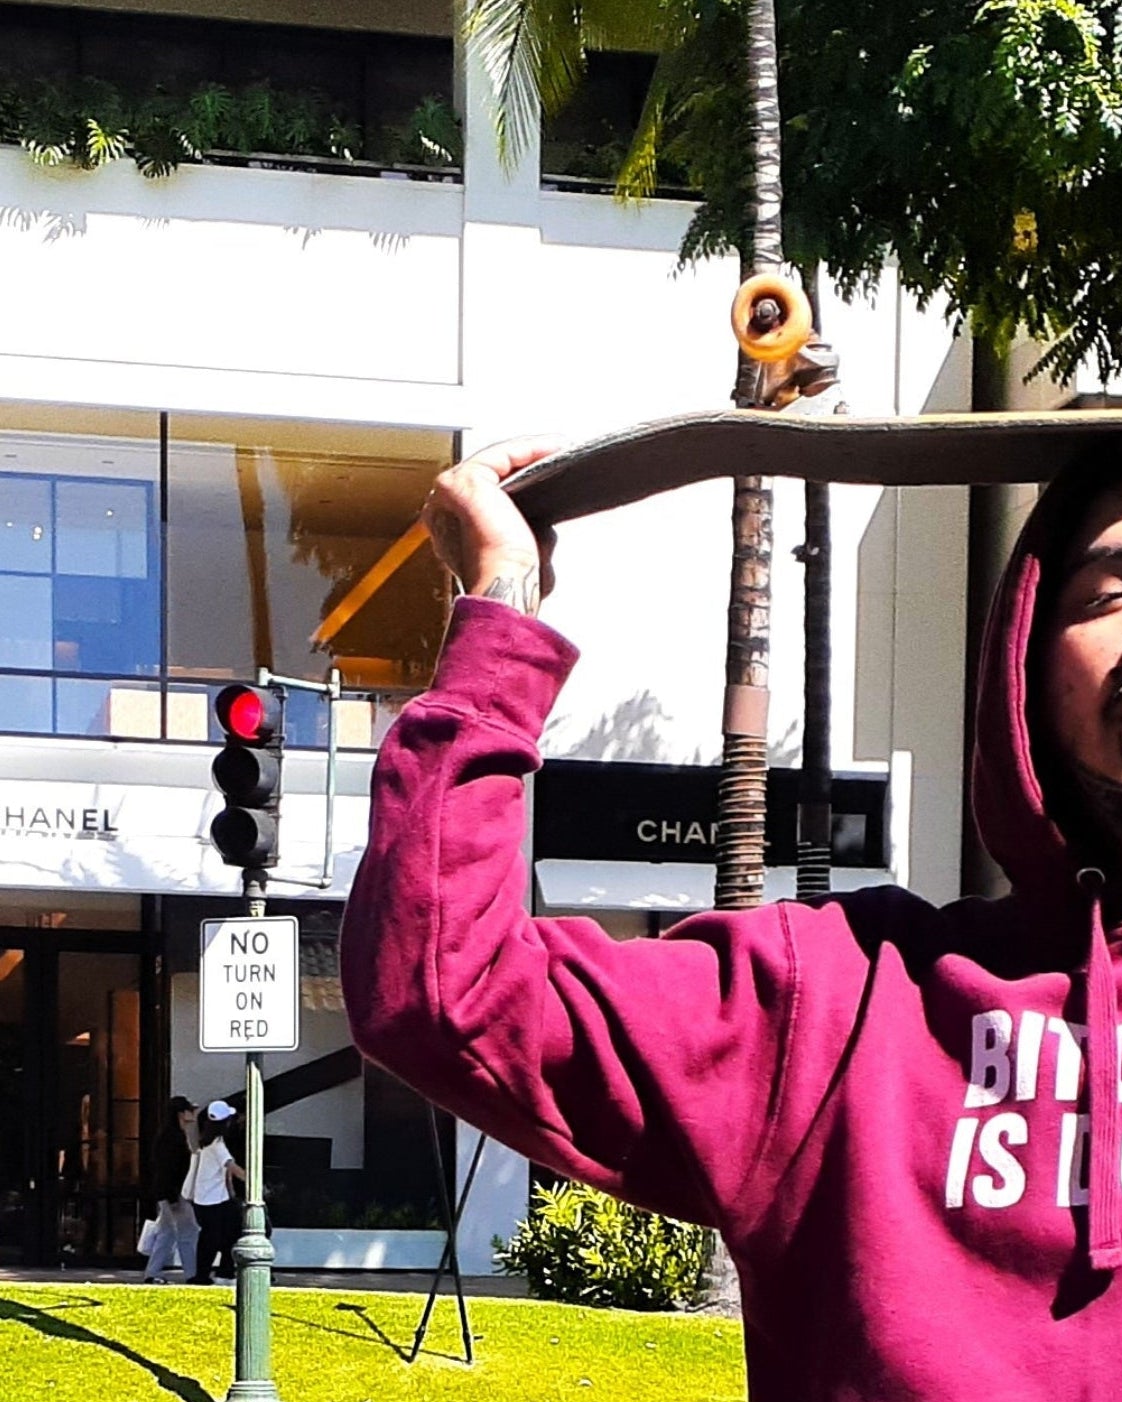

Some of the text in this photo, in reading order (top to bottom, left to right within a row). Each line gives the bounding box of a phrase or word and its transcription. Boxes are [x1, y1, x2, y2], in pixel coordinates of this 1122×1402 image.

[5, 806, 119, 832] HANEL
[230, 929, 269, 955] NO
[223, 964, 276, 983] TURN
[236, 991, 263, 1011] ON
[230, 1019, 268, 1041] RED
[945, 1112, 1029, 1209] IS
